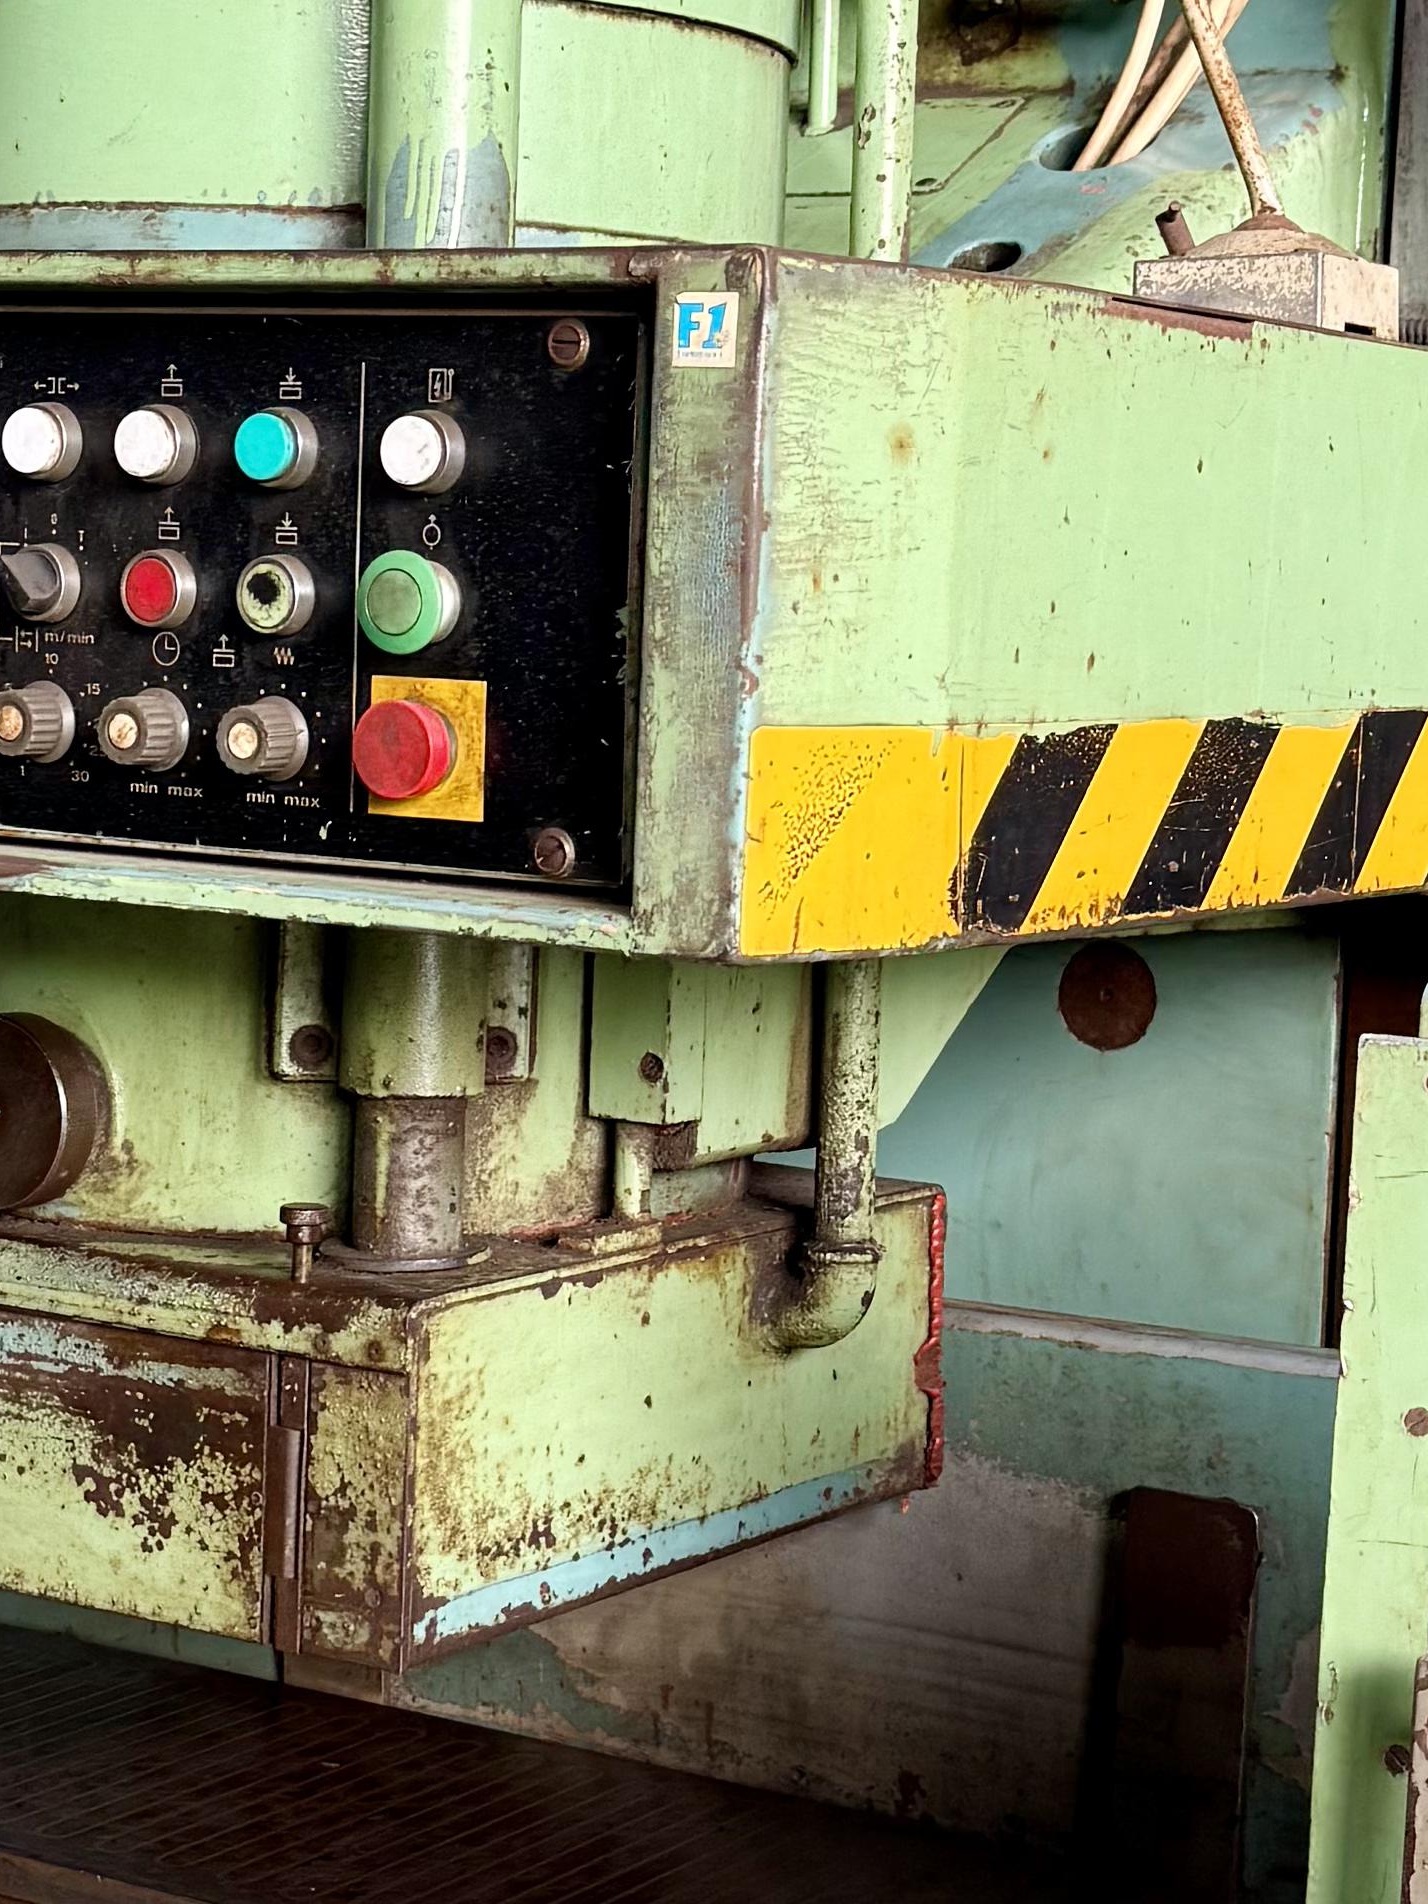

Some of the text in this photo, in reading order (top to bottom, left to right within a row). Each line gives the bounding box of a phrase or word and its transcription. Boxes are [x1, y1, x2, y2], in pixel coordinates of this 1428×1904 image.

[677, 302, 727, 349] F1
[44, 630, 95, 645] m/min
[45, 652, 59, 666] 10
[85, 683, 101, 696] 15
[71, 770, 90, 782] 30
[130, 781, 203, 798] min max
[246, 791, 320, 808] min max
